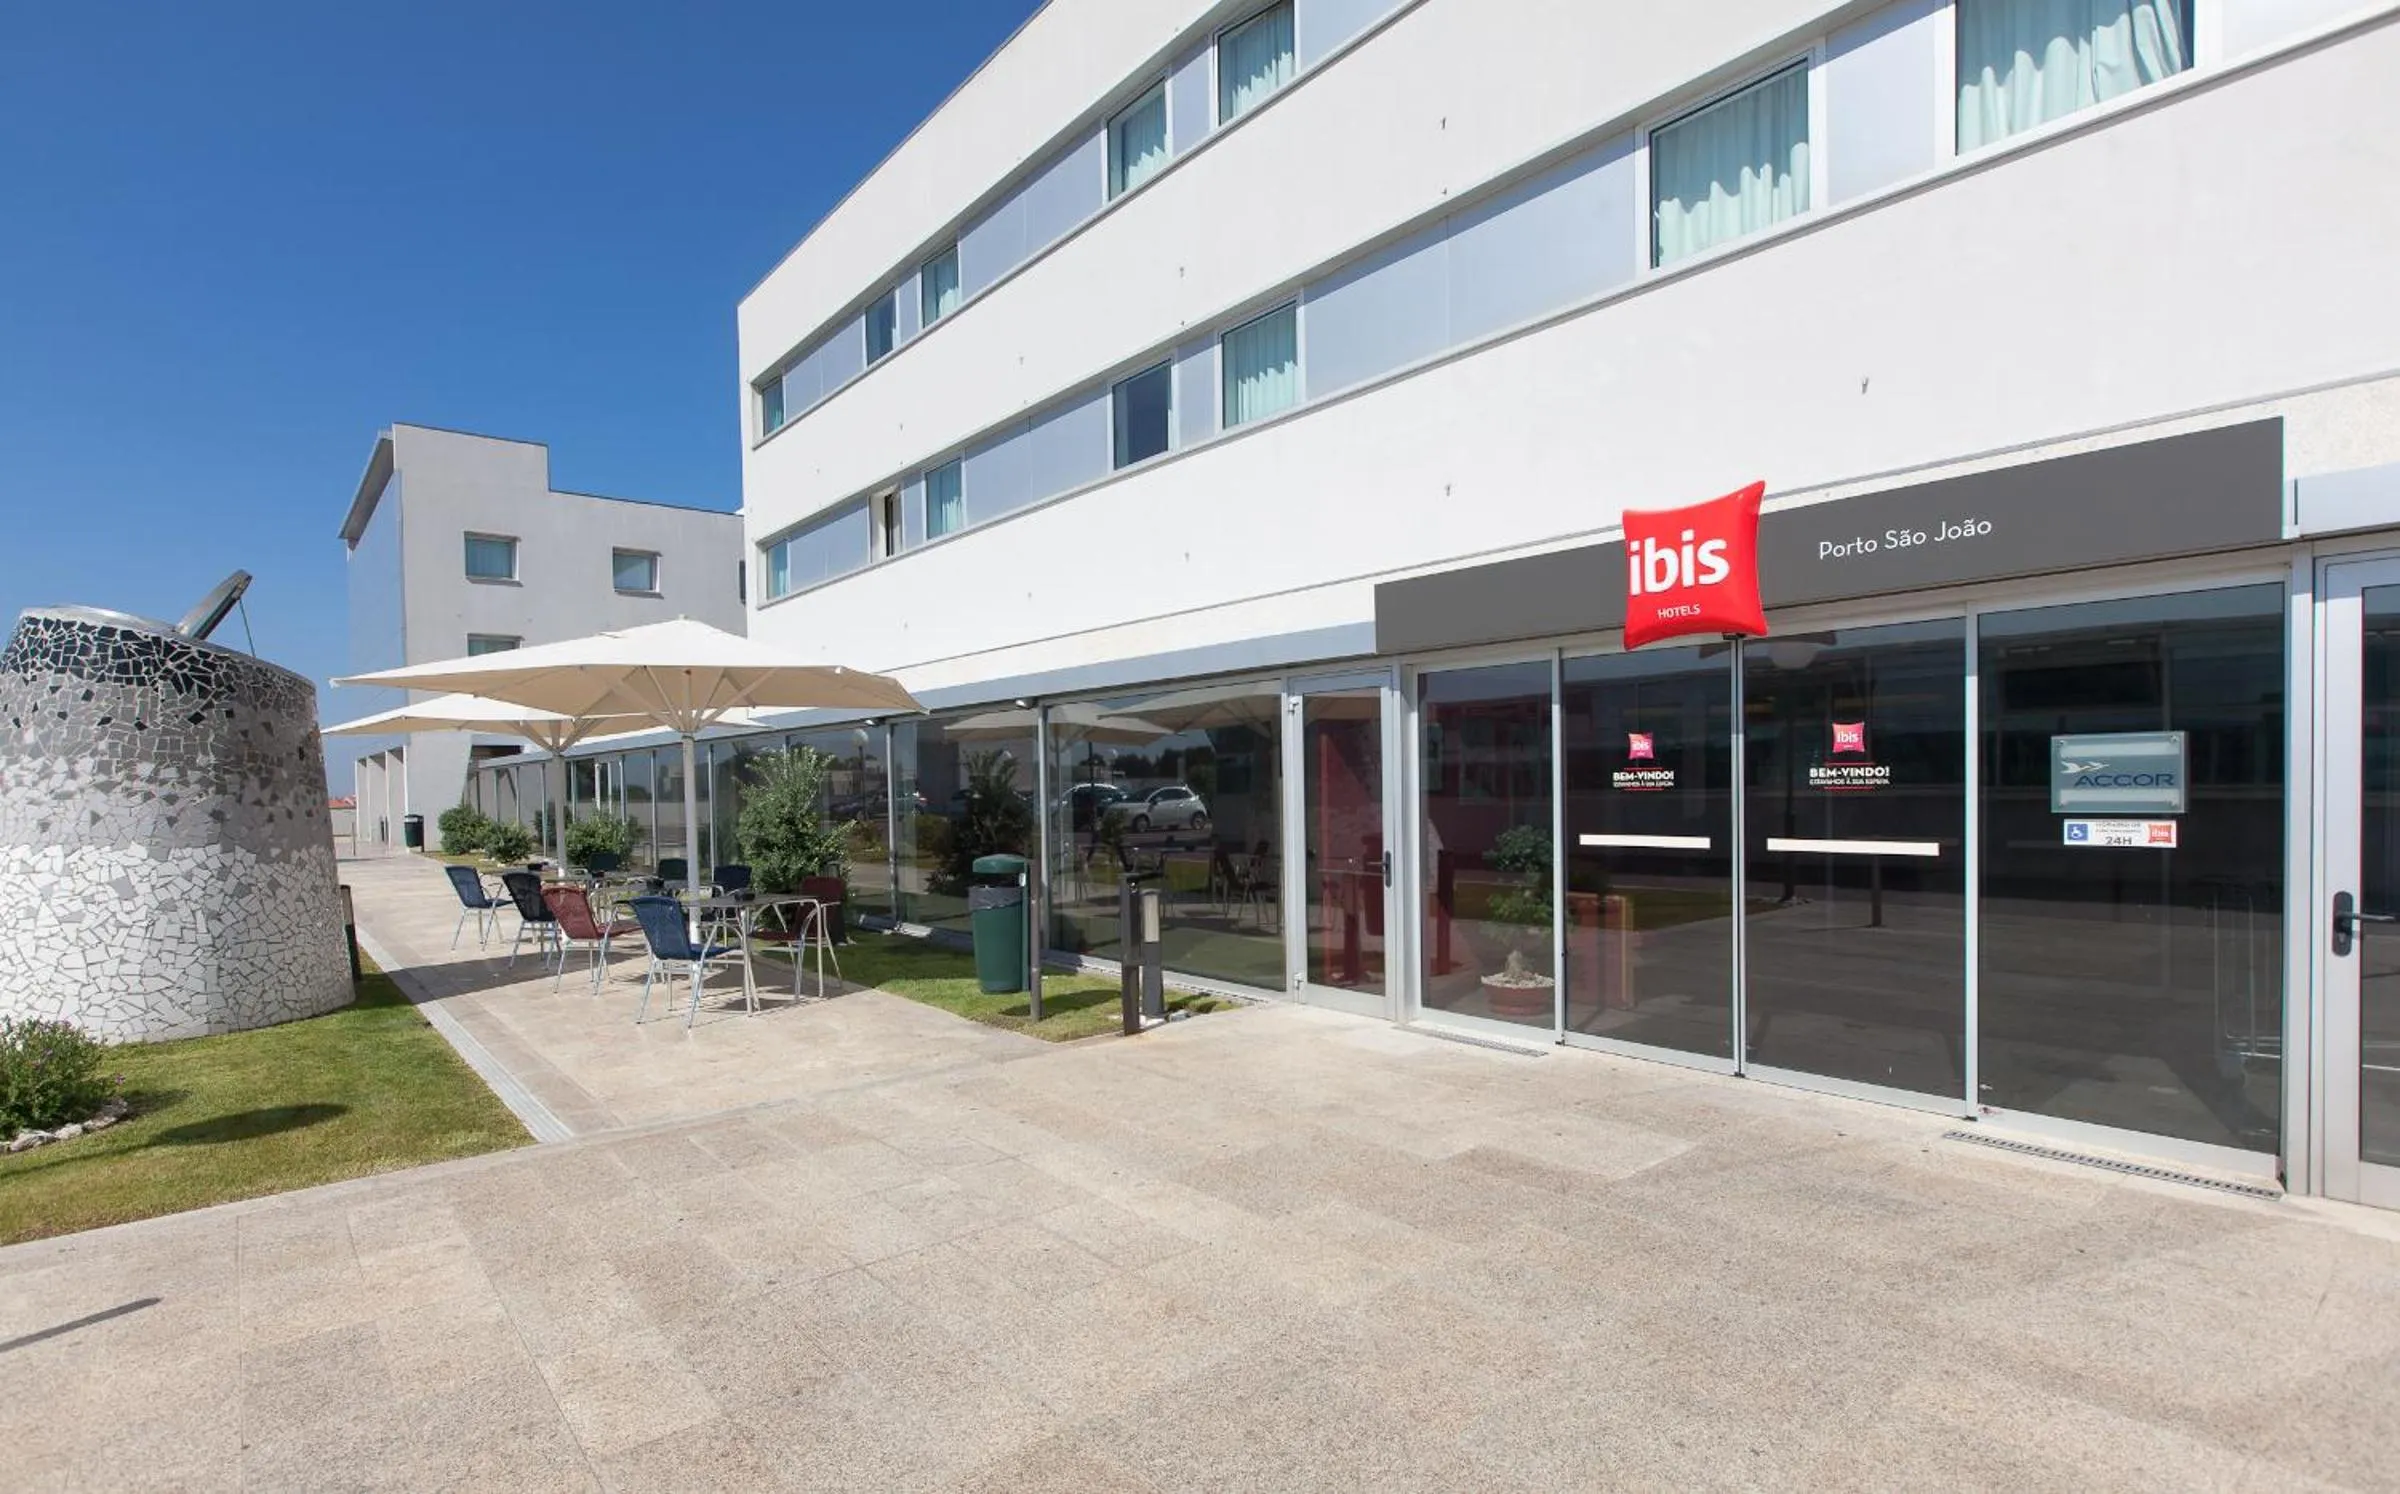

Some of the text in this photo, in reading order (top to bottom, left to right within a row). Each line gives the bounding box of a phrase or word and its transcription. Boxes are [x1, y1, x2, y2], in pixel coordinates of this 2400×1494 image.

[1819, 518, 1992, 560] Porto São João
[1629, 528, 1730, 596] ibis
[1657, 603, 1700, 619] HOTELS
[1836, 731, 1859, 743] ibis
[1612, 770, 1675, 781] BEM-VINDO!
[1808, 766, 1890, 778] BEM-VINDO!
[2074, 773, 2175, 787] ACCOR
[2104, 836, 2132, 846] 24H
